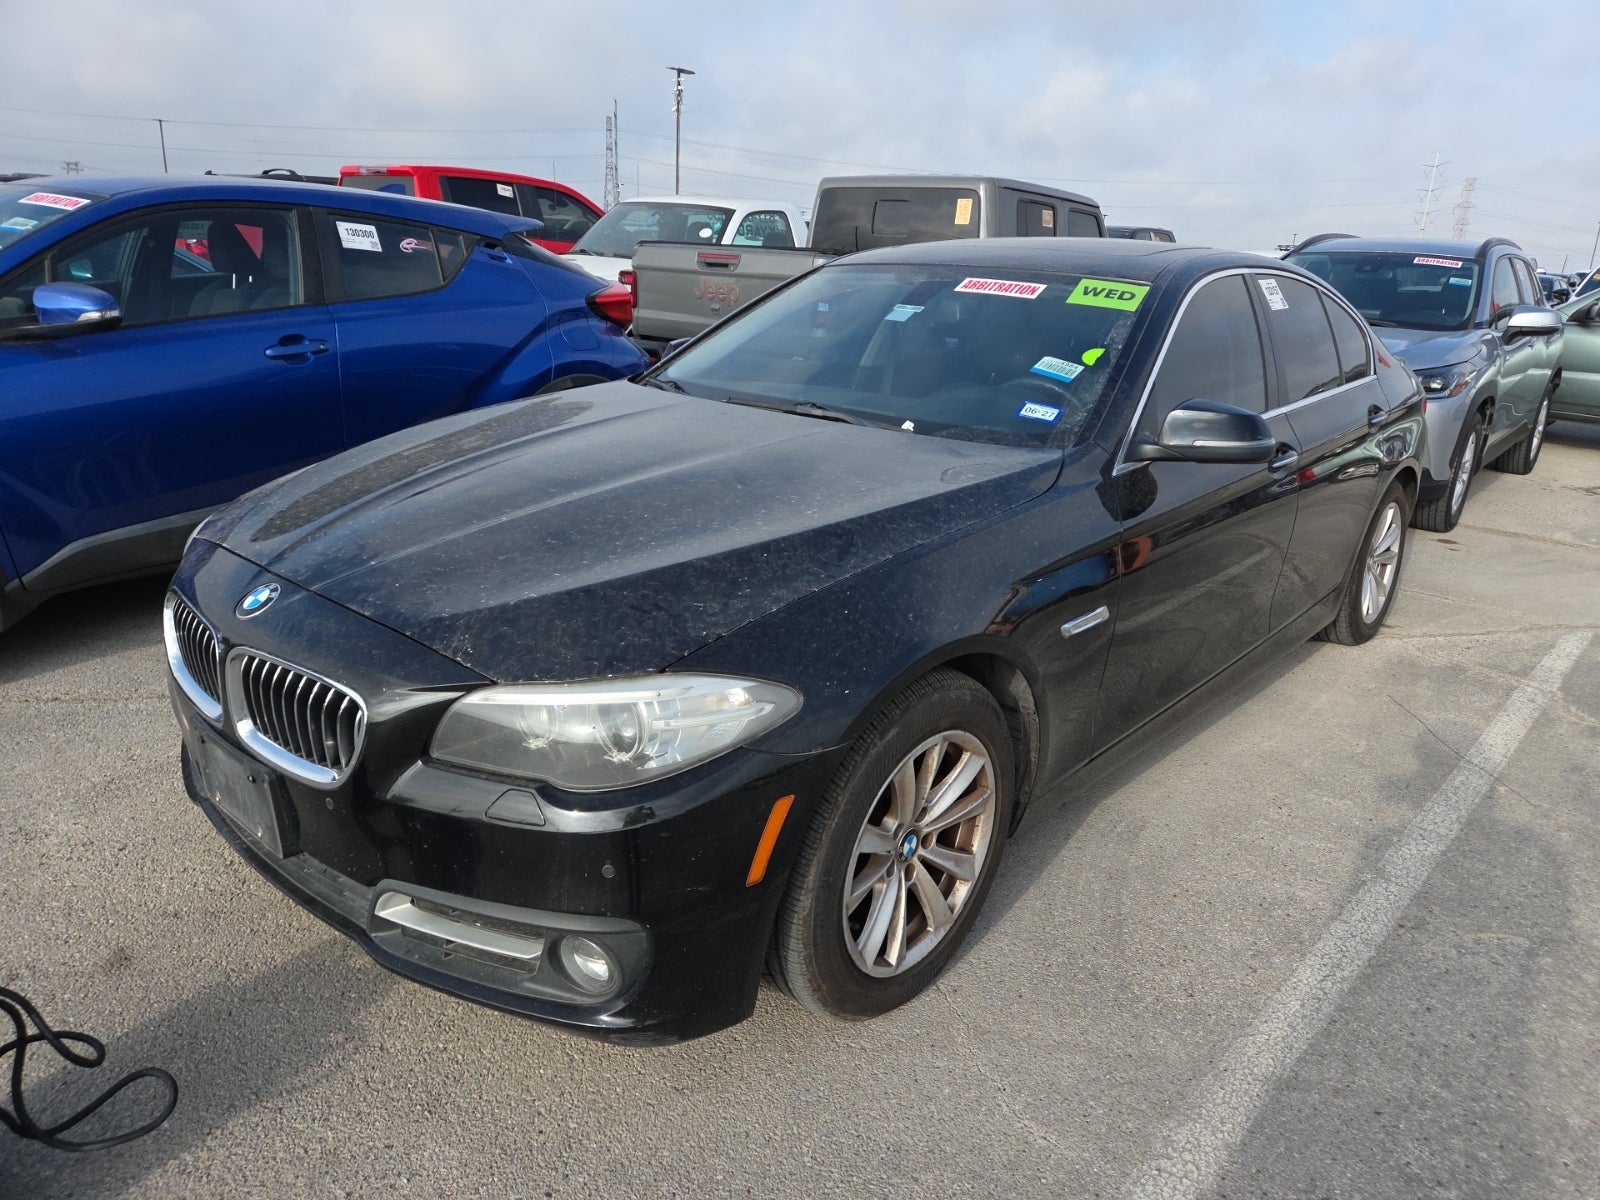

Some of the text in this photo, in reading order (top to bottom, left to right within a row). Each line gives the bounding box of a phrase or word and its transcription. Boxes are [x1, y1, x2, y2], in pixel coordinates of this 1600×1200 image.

[345, 228, 375, 239] 130300
[693, 276, 740, 308] Jeep
[960, 279, 1041, 297] ARBITRATION
[1082, 285, 1137, 301] WED
